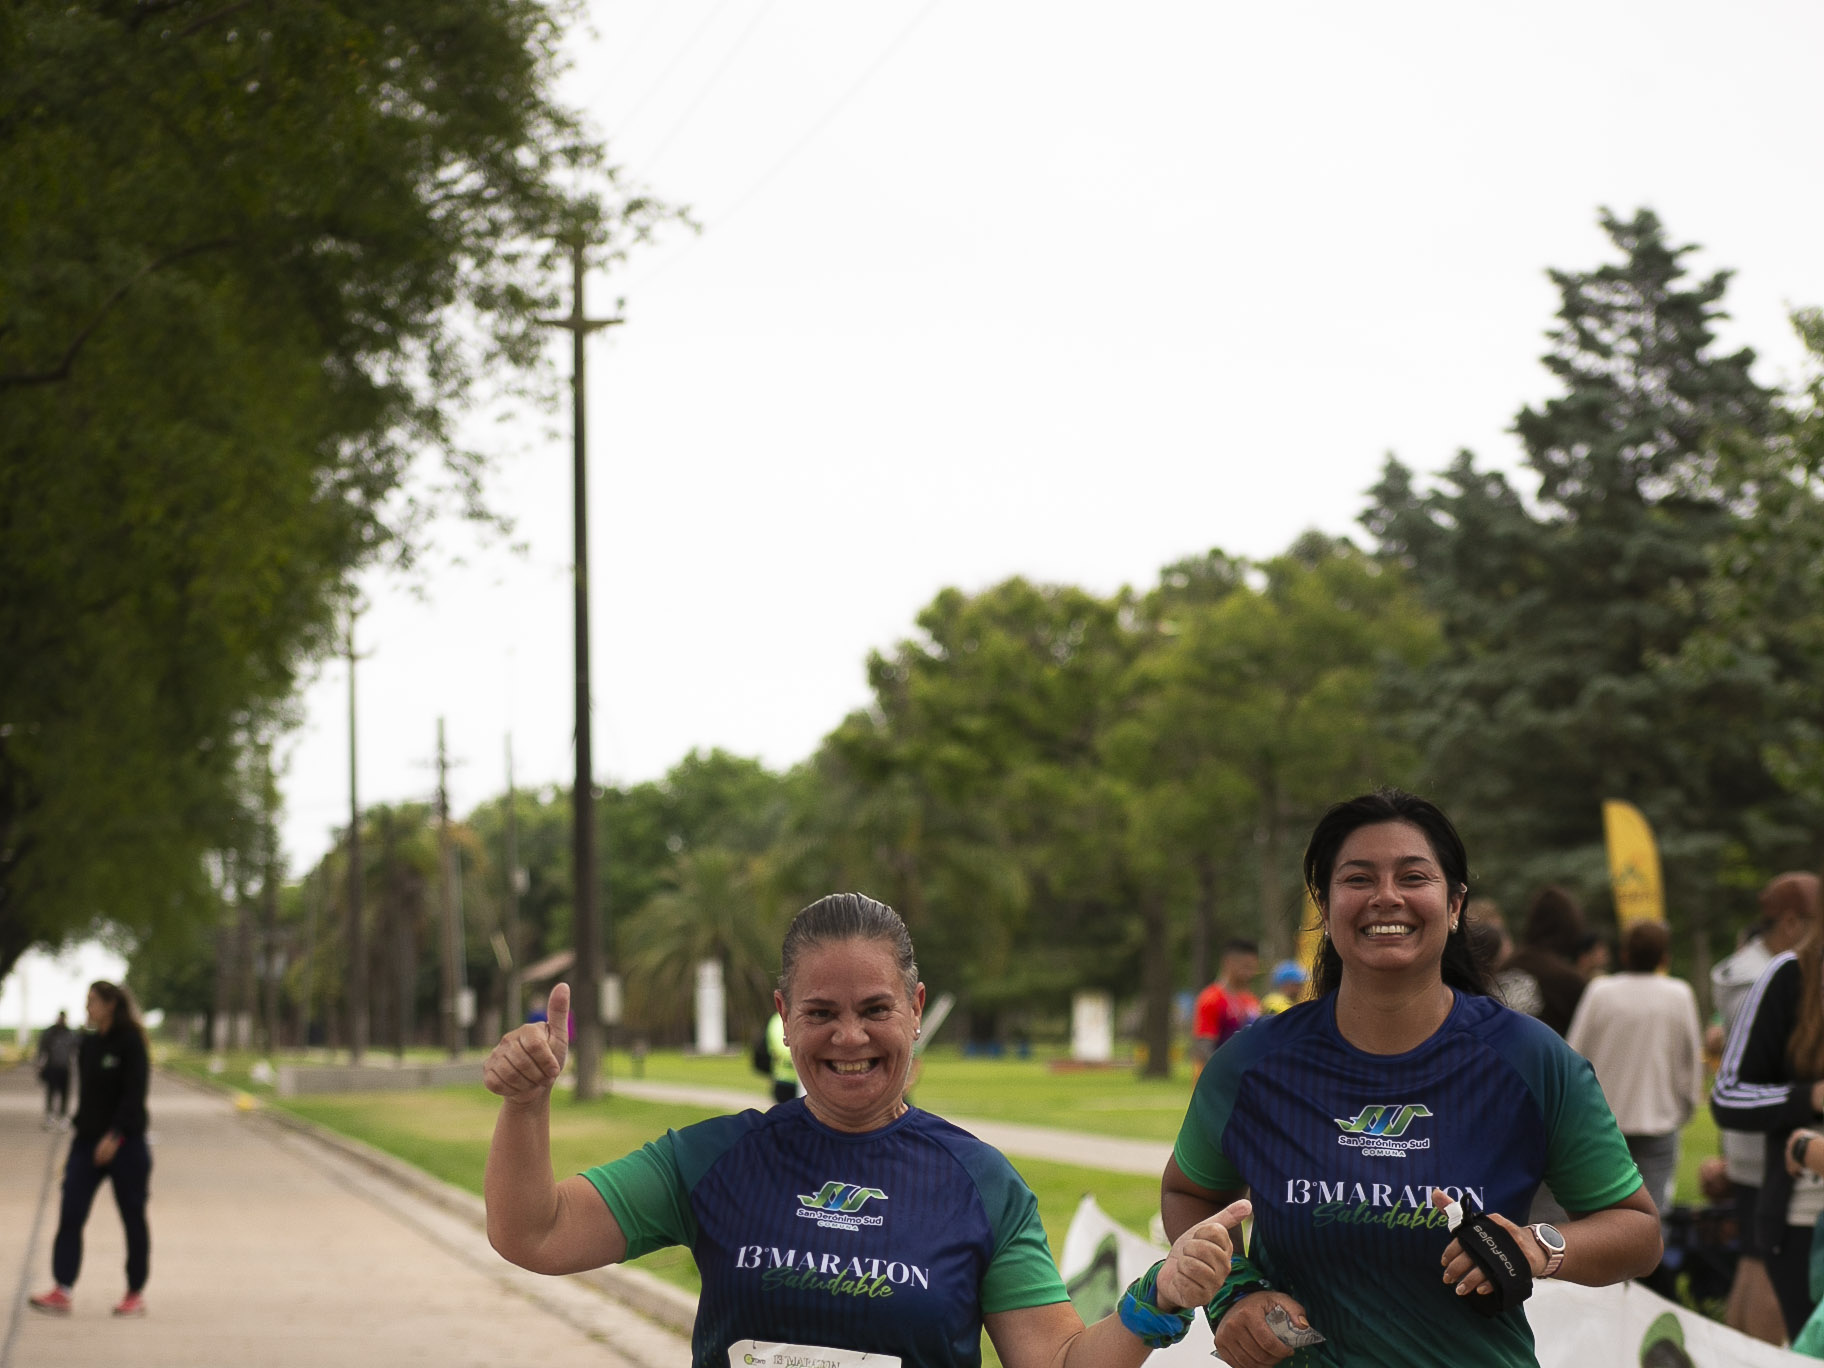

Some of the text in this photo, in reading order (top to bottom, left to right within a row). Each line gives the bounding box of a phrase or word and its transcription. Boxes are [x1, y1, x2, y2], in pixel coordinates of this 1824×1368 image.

[1338, 1135, 1429, 1149] San Jerónimo Sud
[1362, 1149, 1406, 1158] COMUNA
[797, 1208, 883, 1226] San Jerónimo Sud
[818, 1221, 858, 1231] COMUNA
[761, 1266, 894, 1298] Saludable
